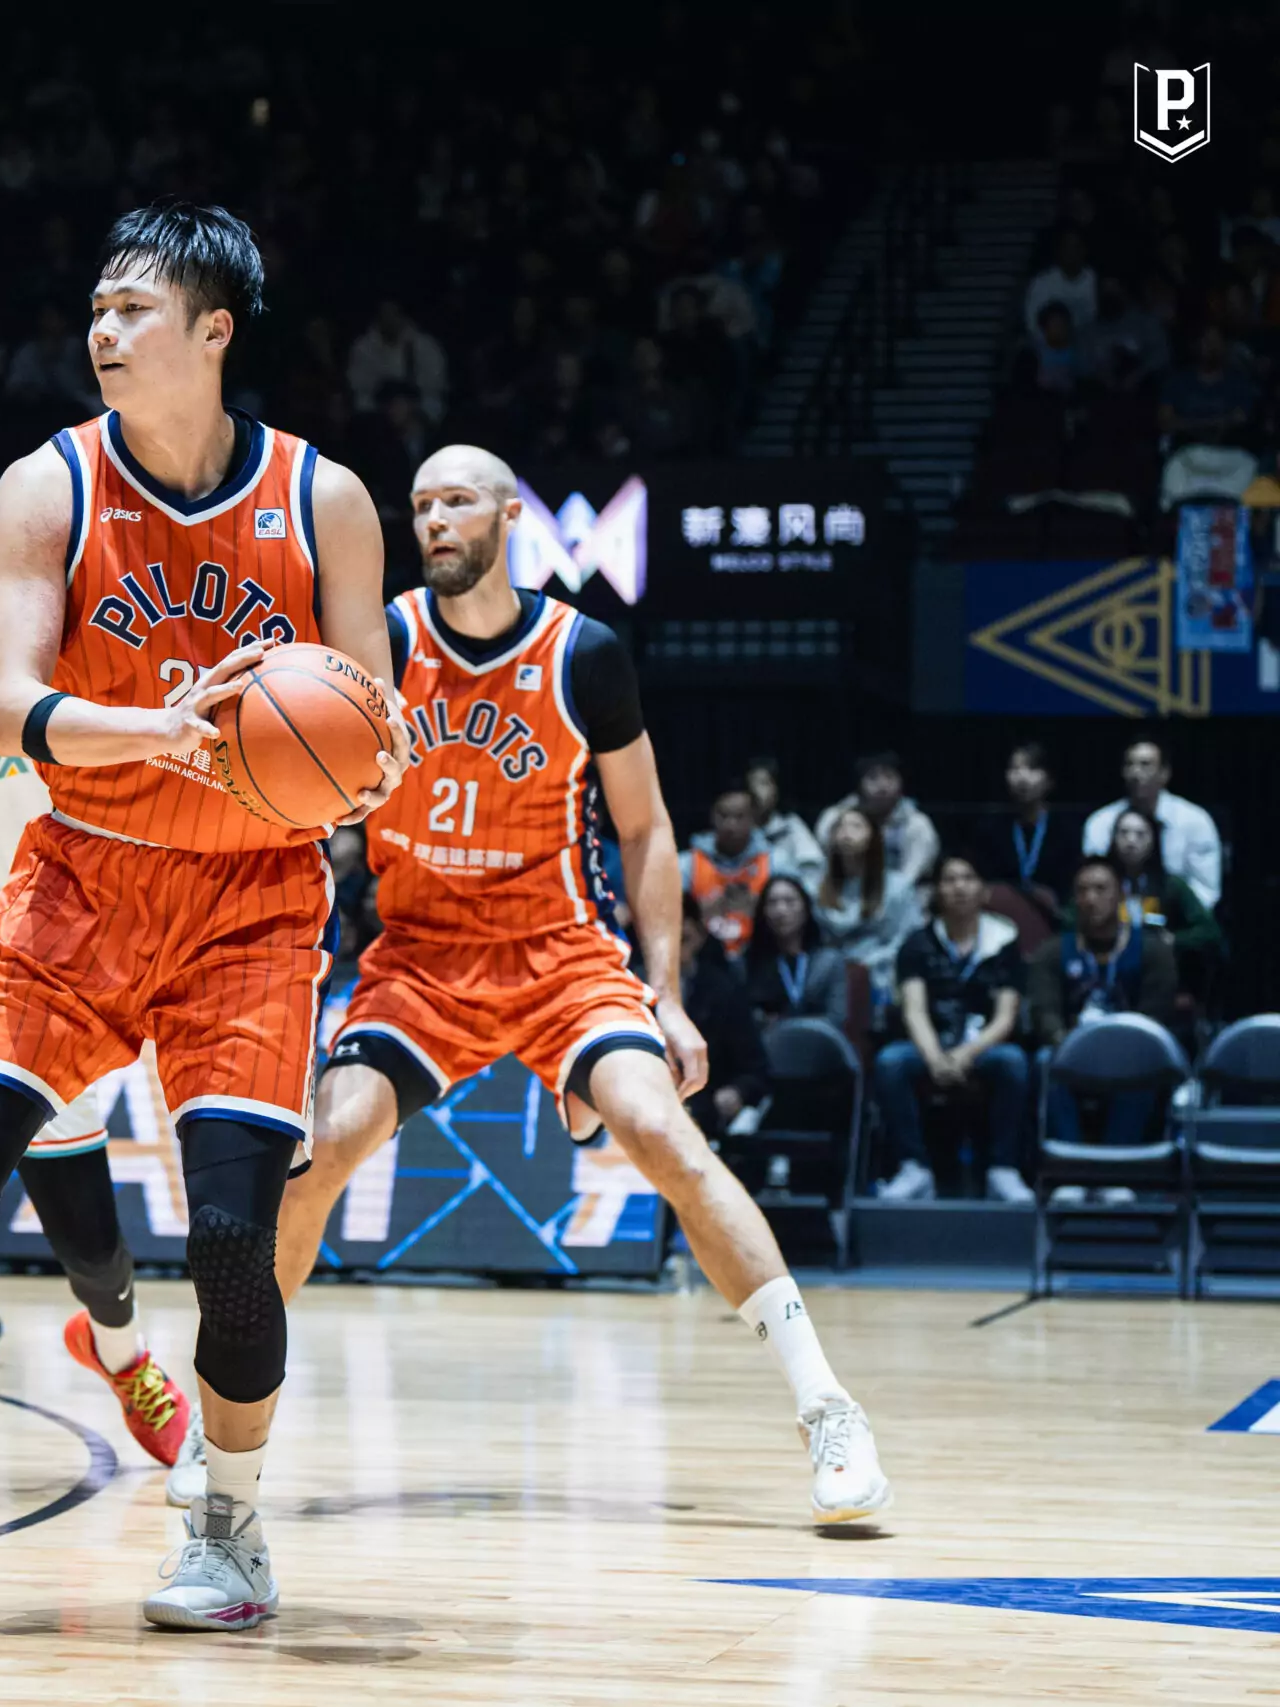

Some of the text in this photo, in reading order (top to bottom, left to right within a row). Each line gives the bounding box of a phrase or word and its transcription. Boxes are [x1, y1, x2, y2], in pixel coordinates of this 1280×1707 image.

[113, 508, 142, 522] asics
[258, 528, 283, 536] EASL
[158, 657, 214, 709] 2
[145, 757, 181, 774] PAUIAN
[428, 777, 480, 837] 21
